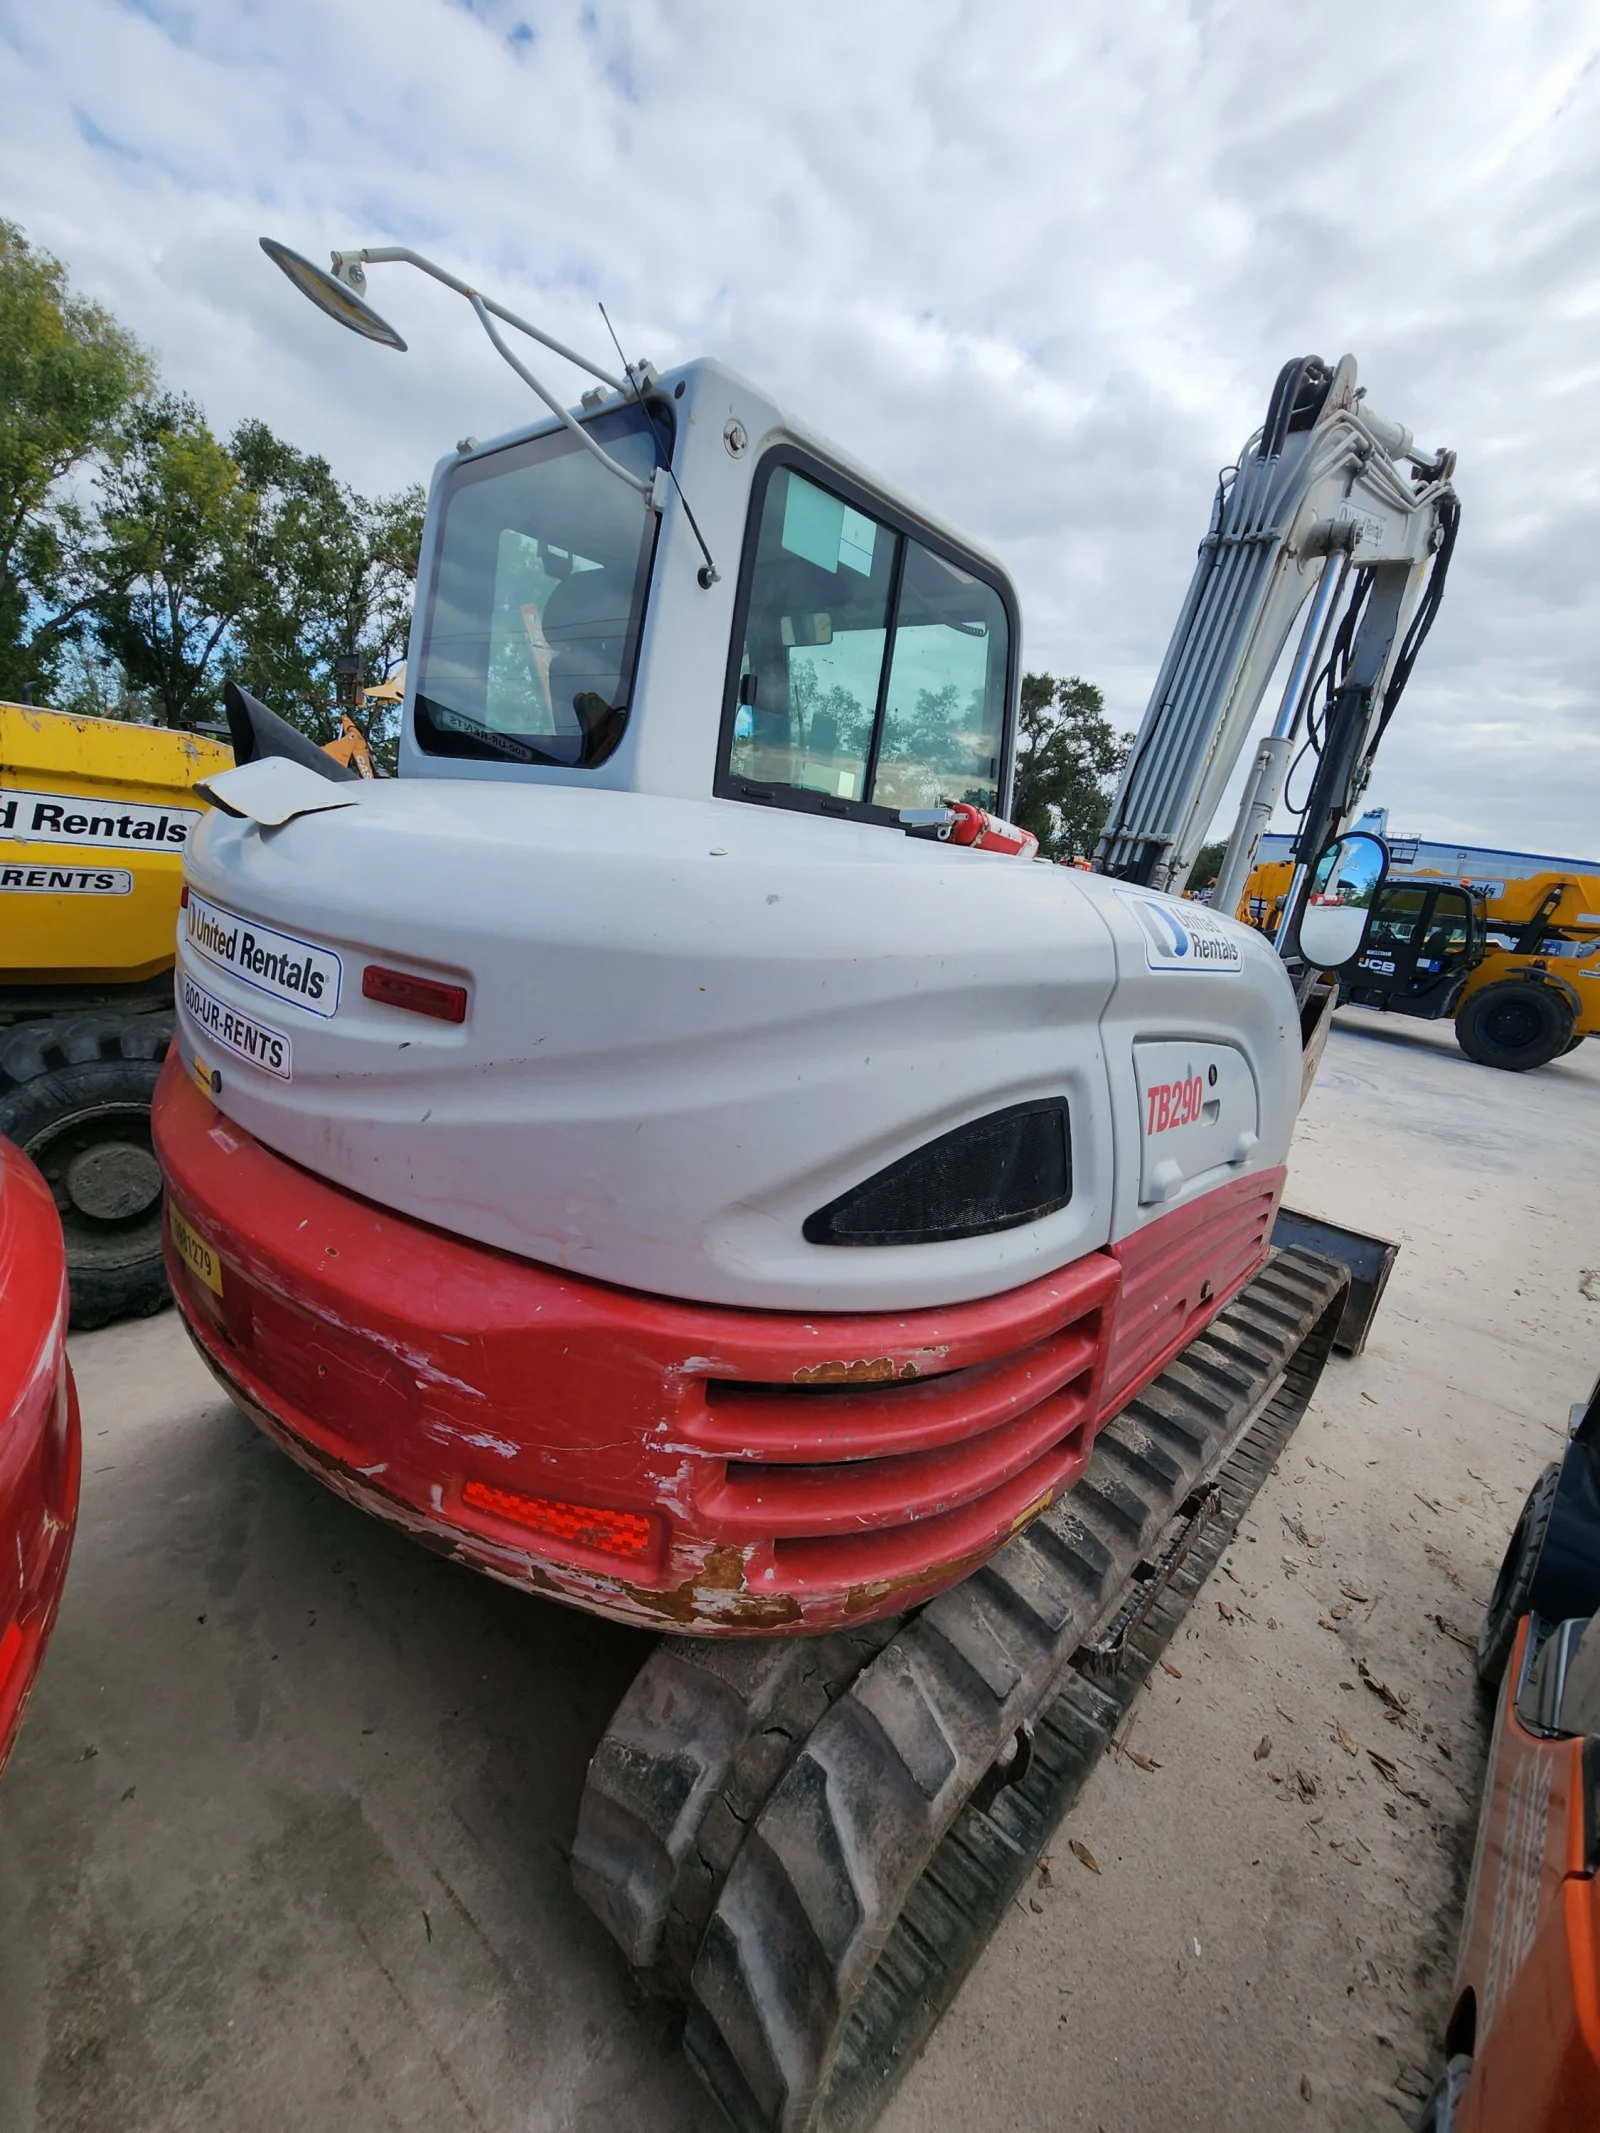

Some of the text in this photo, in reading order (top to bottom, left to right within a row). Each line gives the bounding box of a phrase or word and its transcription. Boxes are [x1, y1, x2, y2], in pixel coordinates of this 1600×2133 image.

[31, 803, 188, 843] Rentals
[1, 869, 115, 890] RENTS
[1169, 907, 1222, 934] United
[197, 912, 325, 999] United Rentals
[1189, 931, 1239, 961] Rentals
[1358, 958, 1396, 973] JCB
[185, 982, 284, 1068] 800-UR-RENTS
[1147, 1076, 1203, 1136] TB290
